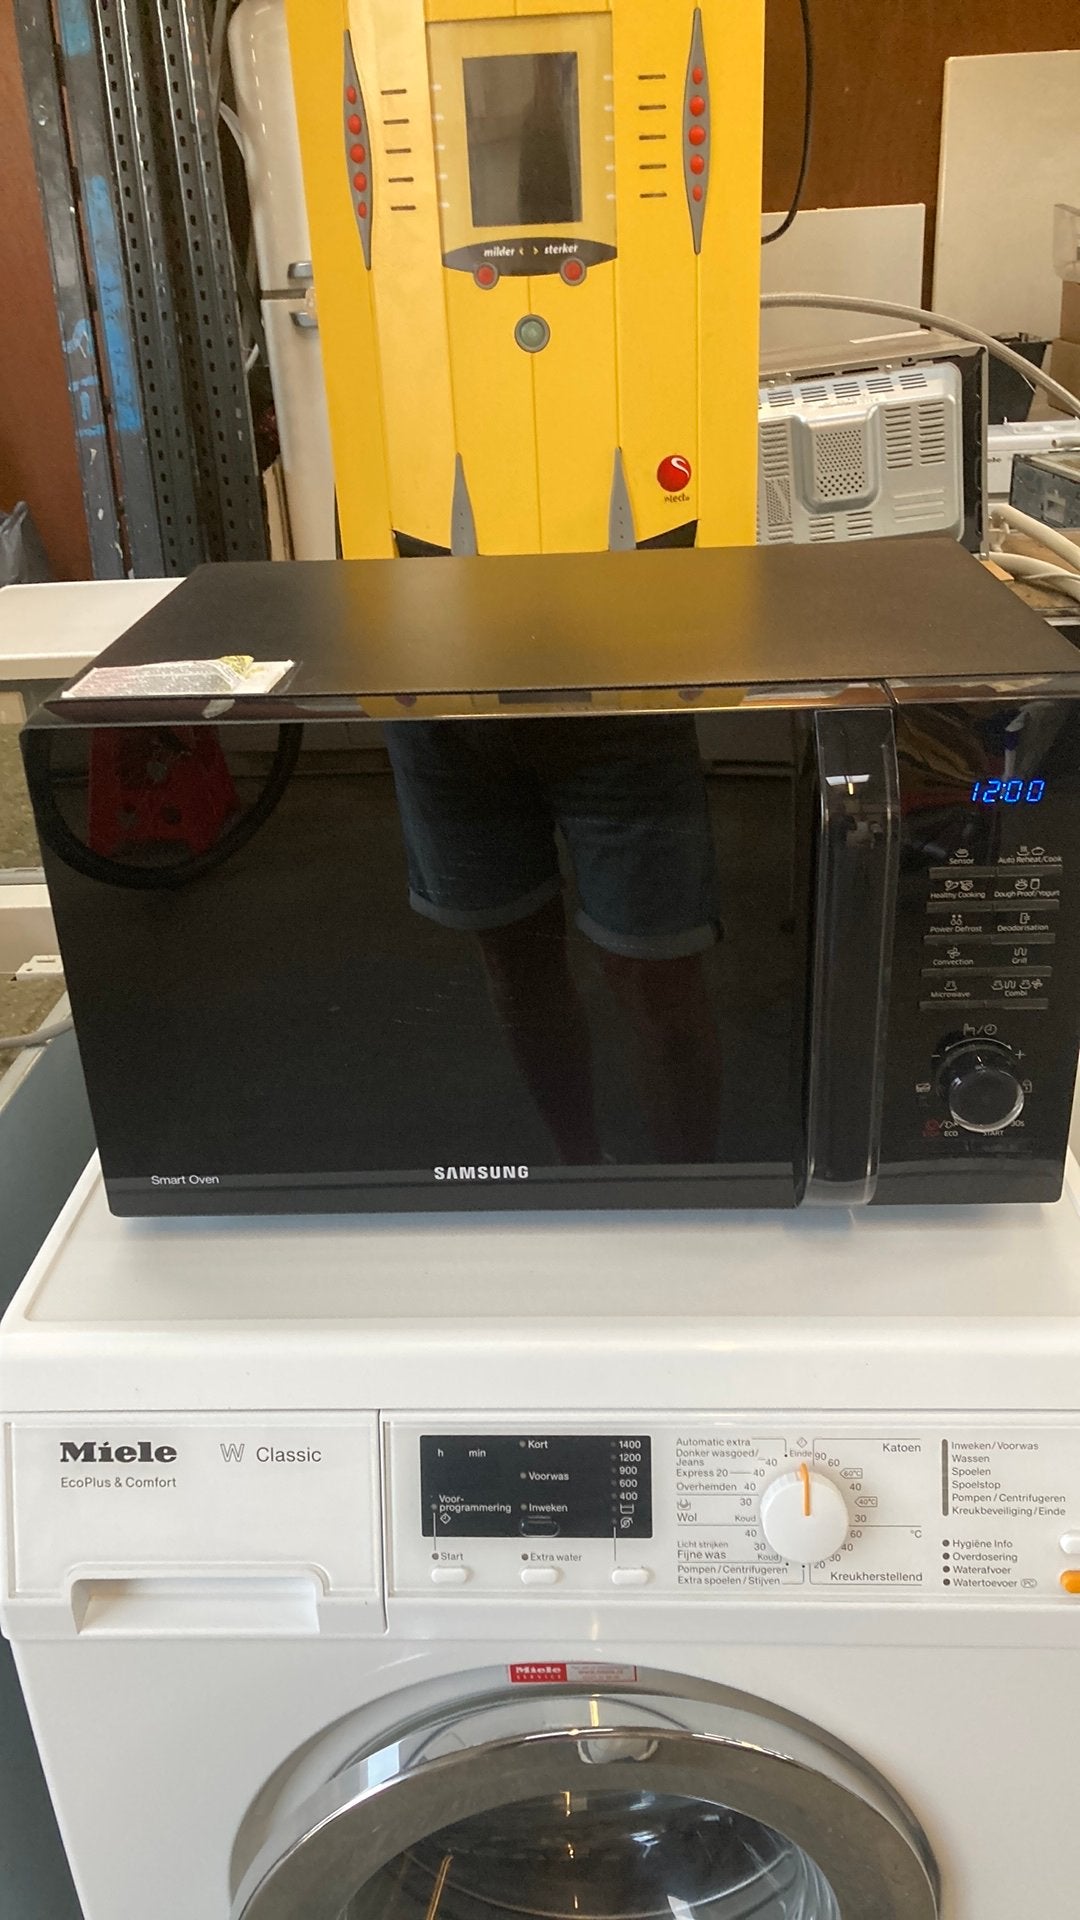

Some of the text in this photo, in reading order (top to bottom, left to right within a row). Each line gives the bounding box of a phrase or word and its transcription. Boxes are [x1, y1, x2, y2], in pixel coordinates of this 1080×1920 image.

[483, 238, 578, 257] milder sterker
[972, 779, 1046, 803] 12:00
[930, 891, 986, 899] Healthy Cooking
[994, 890, 1015, 898] Dough
[955, 925, 982, 933] Defrost
[997, 924, 1049, 932] Deodorisation
[932, 958, 974, 966] Convection
[434, 1165, 529, 1180] SAMSUNG
[151, 1175, 220, 1185] Smart Oven
[528, 1440, 548, 1449] Kort
[619, 1440, 641, 1449] 1400
[676, 1438, 750, 1447] Automatic extra
[60, 1441, 177, 1463] Miele
[882, 1443, 921, 1452] Katoen
[256, 1447, 322, 1463] Classic
[437, 1449, 444, 1457] h
[469, 1448, 486, 1457] min
[676, 1449, 709, 1457] Donker
[619, 1453, 641, 1462] 1200
[952, 1454, 990, 1463] Wassen
[828, 1459, 840, 1467] 60
[619, 1466, 637, 1475] 900
[676, 1469, 765, 1478] Express 20 40
[952, 1467, 991, 1477] Spoelen
[529, 1472, 569, 1481] Voorwas
[61, 1476, 177, 1489] EcoPlus & Comfort
[619, 1479, 638, 1488] 600
[677, 1483, 756, 1491] Overhemden 40
[849, 1483, 862, 1491] 40
[952, 1480, 1001, 1490] Spoelstop
[439, 1494, 464, 1503] Voor-
[619, 1492, 638, 1500] 400
[952, 1493, 991, 1503] Pompen
[999, 1493, 1066, 1503] Centrifugeren
[740, 1498, 752, 1506] 30
[440, 1503, 512, 1513] programmering
[529, 1504, 568, 1513] Inweken
[677, 1513, 697, 1522] Wol
[854, 1515, 867, 1523] 30
[850, 1530, 863, 1538] 60
[910, 1530, 922, 1538] °C
[699, 1541, 728, 1549] strijken
[841, 1543, 853, 1551] 40
[952, 1539, 1013, 1549] Hygiëne Info
[441, 1552, 464, 1561] Start
[530, 1553, 582, 1561] Extra water
[678, 1550, 703, 1560] Fijne
[952, 1553, 1018, 1563] Overdosering
[814, 1561, 826, 1569] 20
[678, 1566, 716, 1575] Pompen
[953, 1566, 1012, 1574] Waterafvoer
[678, 1576, 702, 1584] Extra
[704, 1576, 741, 1586] spoelen
[749, 1577, 780, 1586] Stijven
[831, 1571, 923, 1582] Kreukherstellend
[953, 1579, 1017, 1588] Watertoevoer
[515, 1666, 561, 1674] Miele
